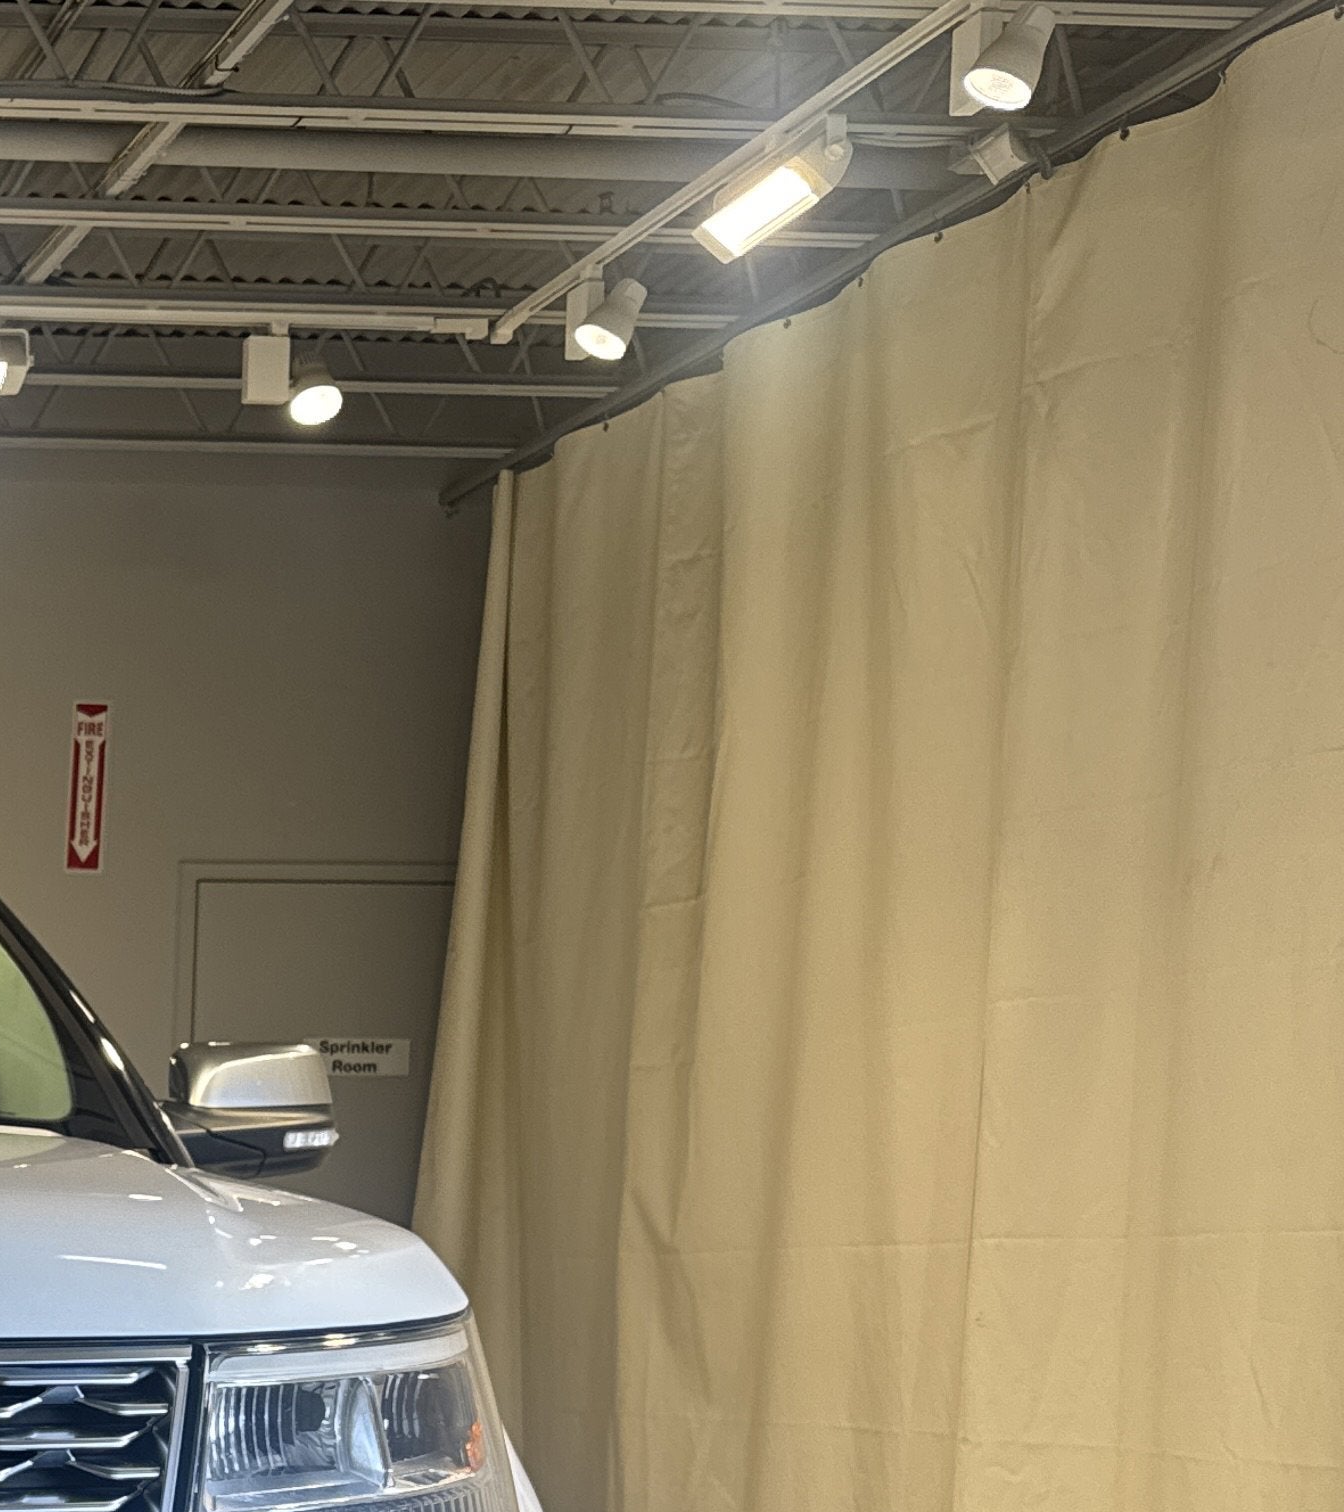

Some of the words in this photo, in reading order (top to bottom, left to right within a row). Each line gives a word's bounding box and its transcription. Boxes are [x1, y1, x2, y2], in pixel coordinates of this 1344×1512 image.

[77, 721, 104, 736] FIRE
[319, 1040, 392, 1055] Sprinkler
[332, 1060, 377, 1073] Room
